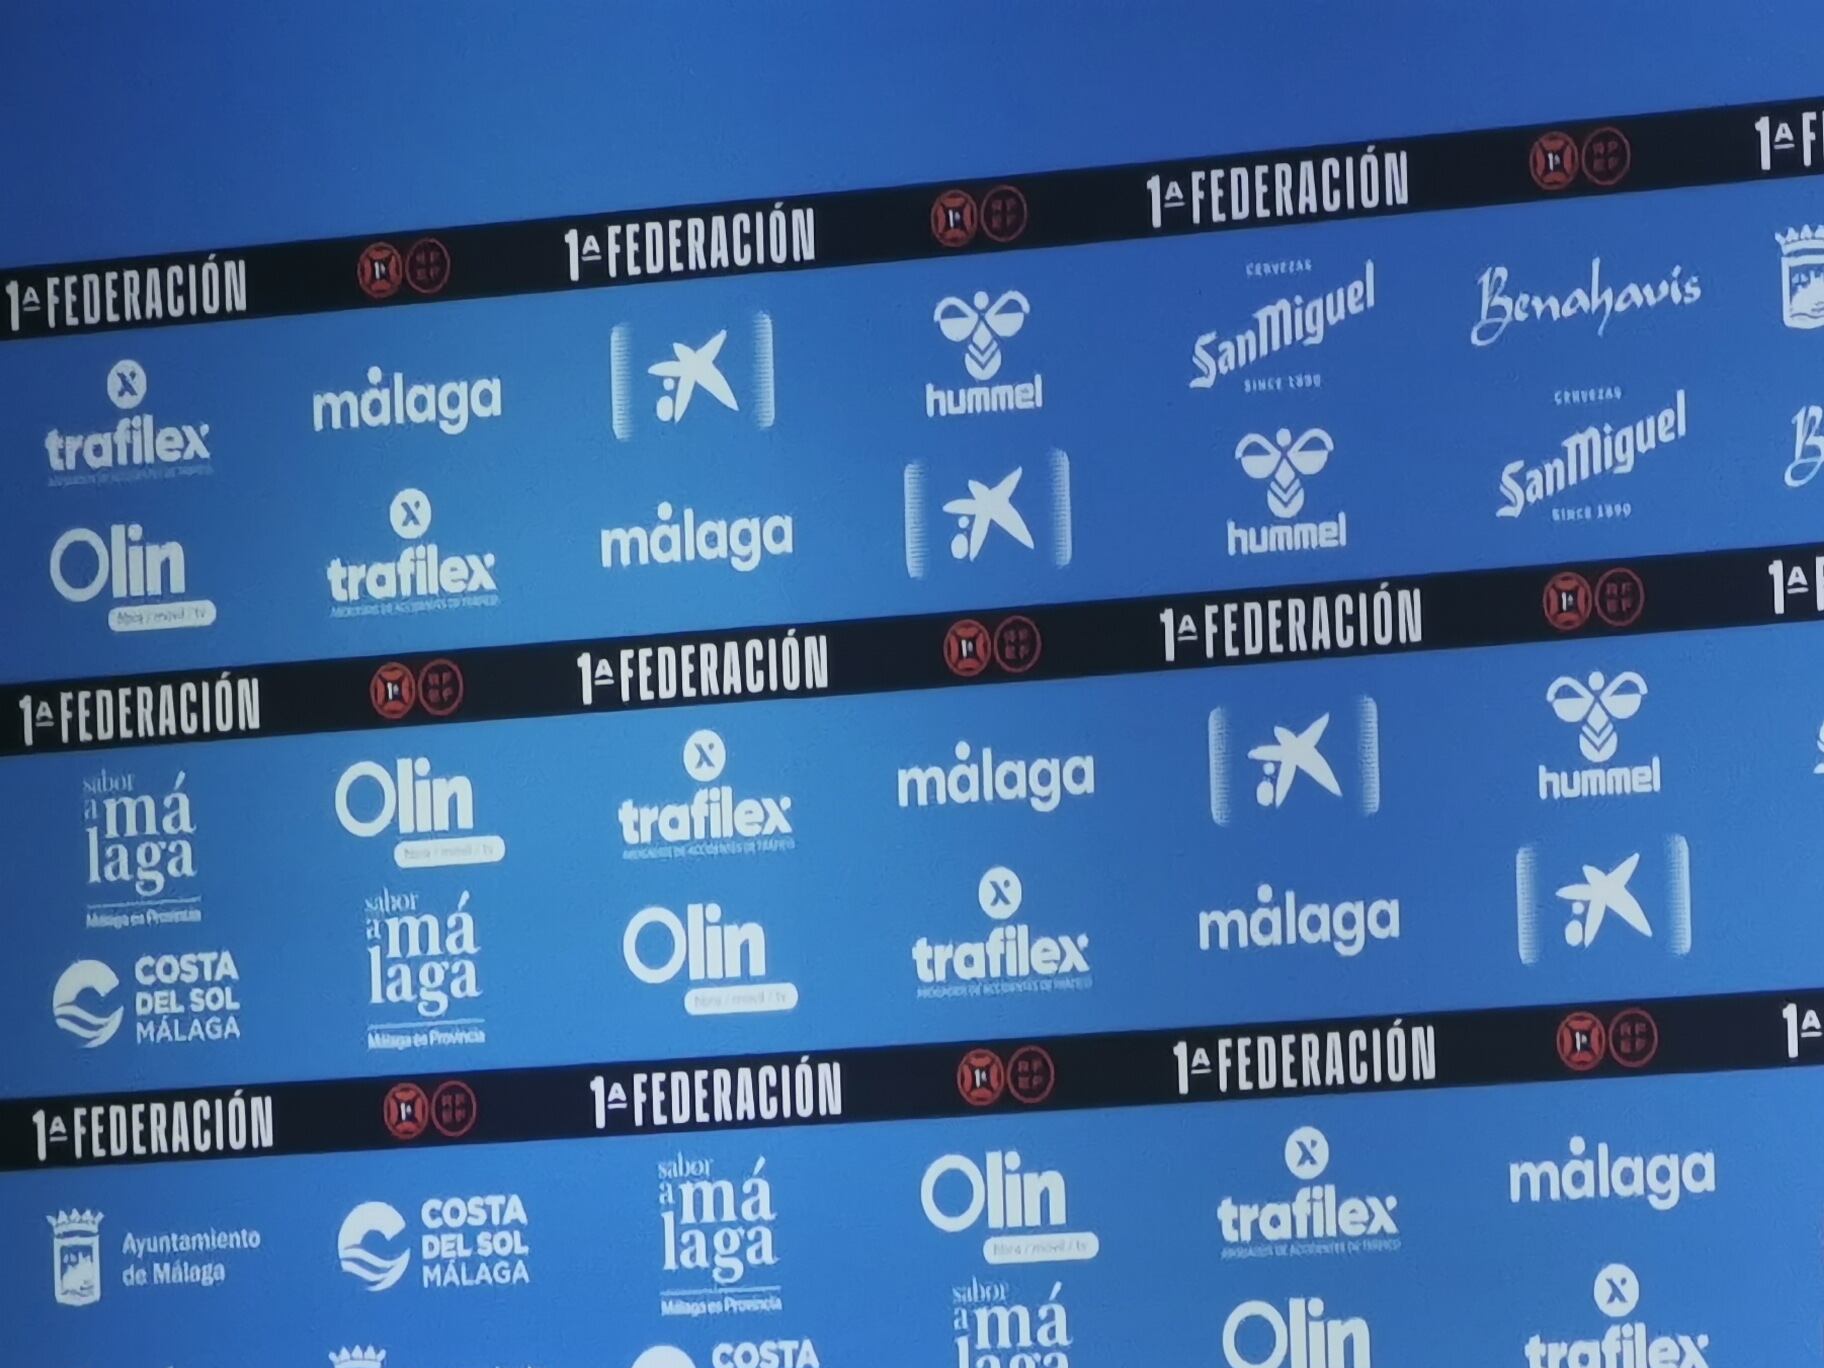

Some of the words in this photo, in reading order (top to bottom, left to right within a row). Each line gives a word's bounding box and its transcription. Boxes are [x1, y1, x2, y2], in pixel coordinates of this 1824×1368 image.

[1191, 145, 1409, 224] FEDERACIÓN
[607, 201, 815, 278] FEDERACIÓN
[47, 253, 247, 328] FEDERACIÓN
[925, 373, 1043, 418] hummel
[45, 414, 210, 471] trafilex
[49, 523, 186, 602] Olin
[1227, 511, 1347, 556] hummel
[326, 543, 497, 602] trafilex
[1204, 582, 1422, 659] FEDERACIÓN
[620, 628, 828, 702] FEDERACIÓN
[60, 671, 260, 743] FEDERACIÓN
[334, 757, 474, 838] Olin
[1538, 756, 1661, 800] hummel
[618, 785, 793, 845] trafilex
[135, 950, 239, 985] COSTA
[622, 903, 766, 984] Olin
[911, 924, 1090, 983] trafilex
[135, 989, 185, 1016] DEL
[189, 986, 241, 1012] SOL
[136, 1015, 241, 1043] MÁLAGA
[1218, 1018, 1436, 1093] FEDERACIÓN
[633, 1055, 842, 1127] FEDERACIÓN
[73, 1089, 274, 1159] FEDERACIÓN
[421, 1194, 528, 1229] COSTA
[920, 1150, 1067, 1233] Olin
[1217, 1184, 1398, 1243] trafilex
[421, 1233, 473, 1260] DEL
[476, 1229, 530, 1257] SOL
[422, 1259, 530, 1288] MÁLAGA
